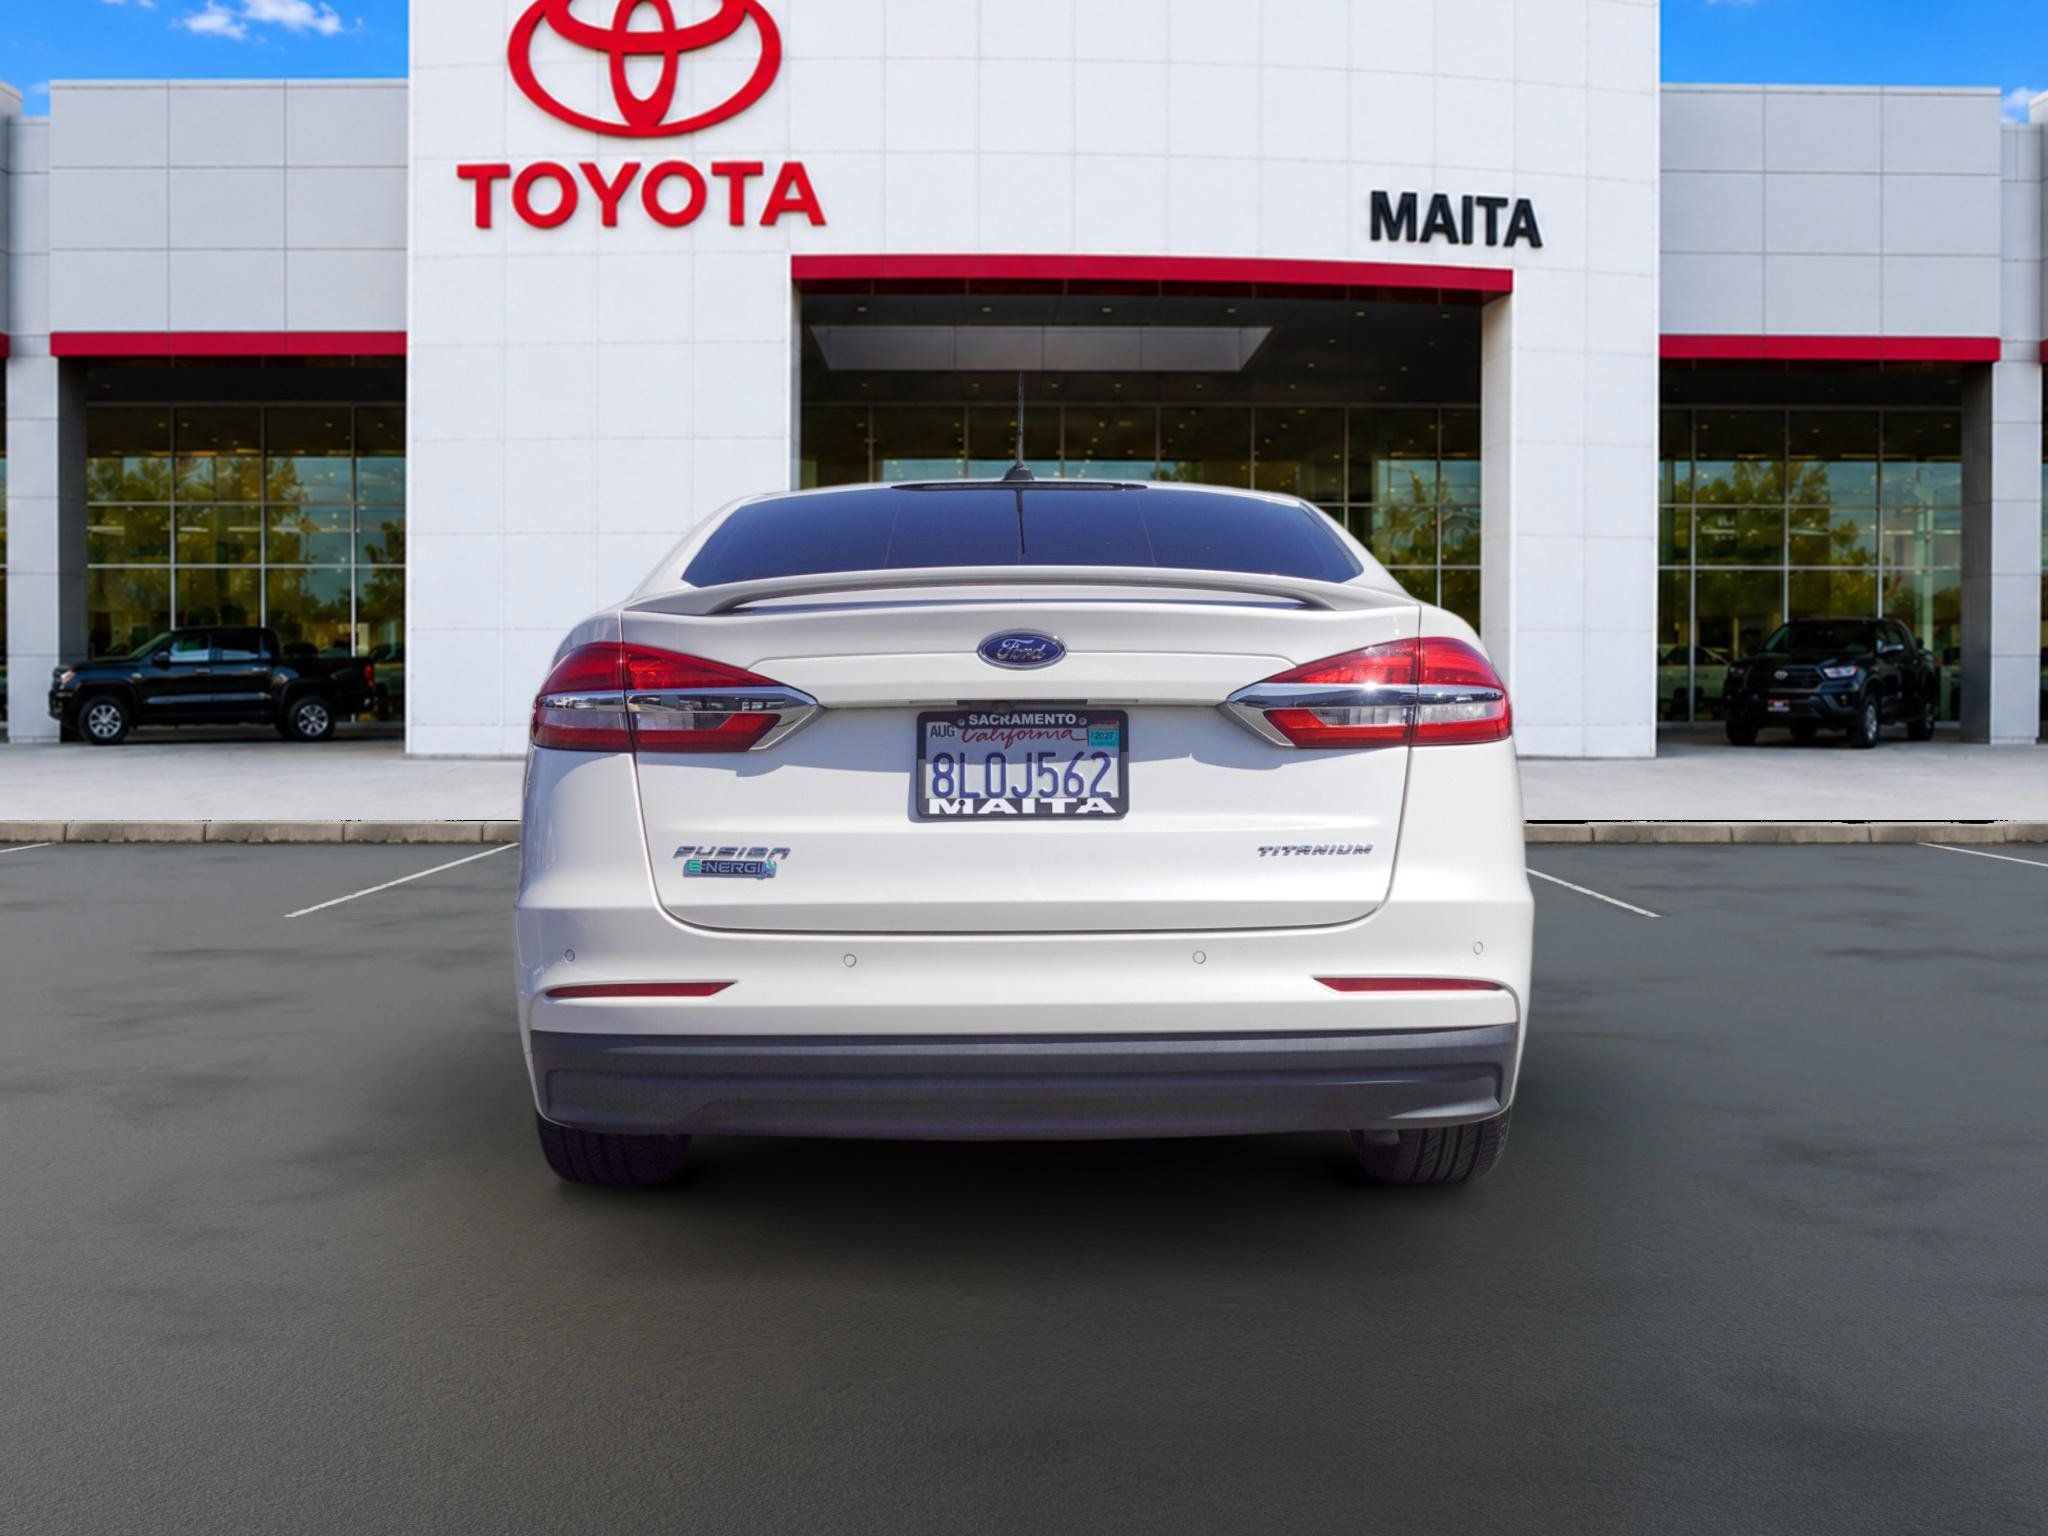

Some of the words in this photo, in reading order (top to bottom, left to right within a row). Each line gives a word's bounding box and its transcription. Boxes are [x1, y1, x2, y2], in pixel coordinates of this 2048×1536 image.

[457, 161, 827, 229] TOYOTA
[1370, 191, 1543, 248] MAITA
[997, 638, 1046, 660] Ford
[968, 713, 1077, 726] SACRAMENTO
[929, 724, 956, 738] AUG
[961, 727, 1073, 750] California
[928, 799, 1117, 814] MAITA
[672, 845, 791, 861] FUSION
[1257, 843, 1374, 857] TITANIUM
